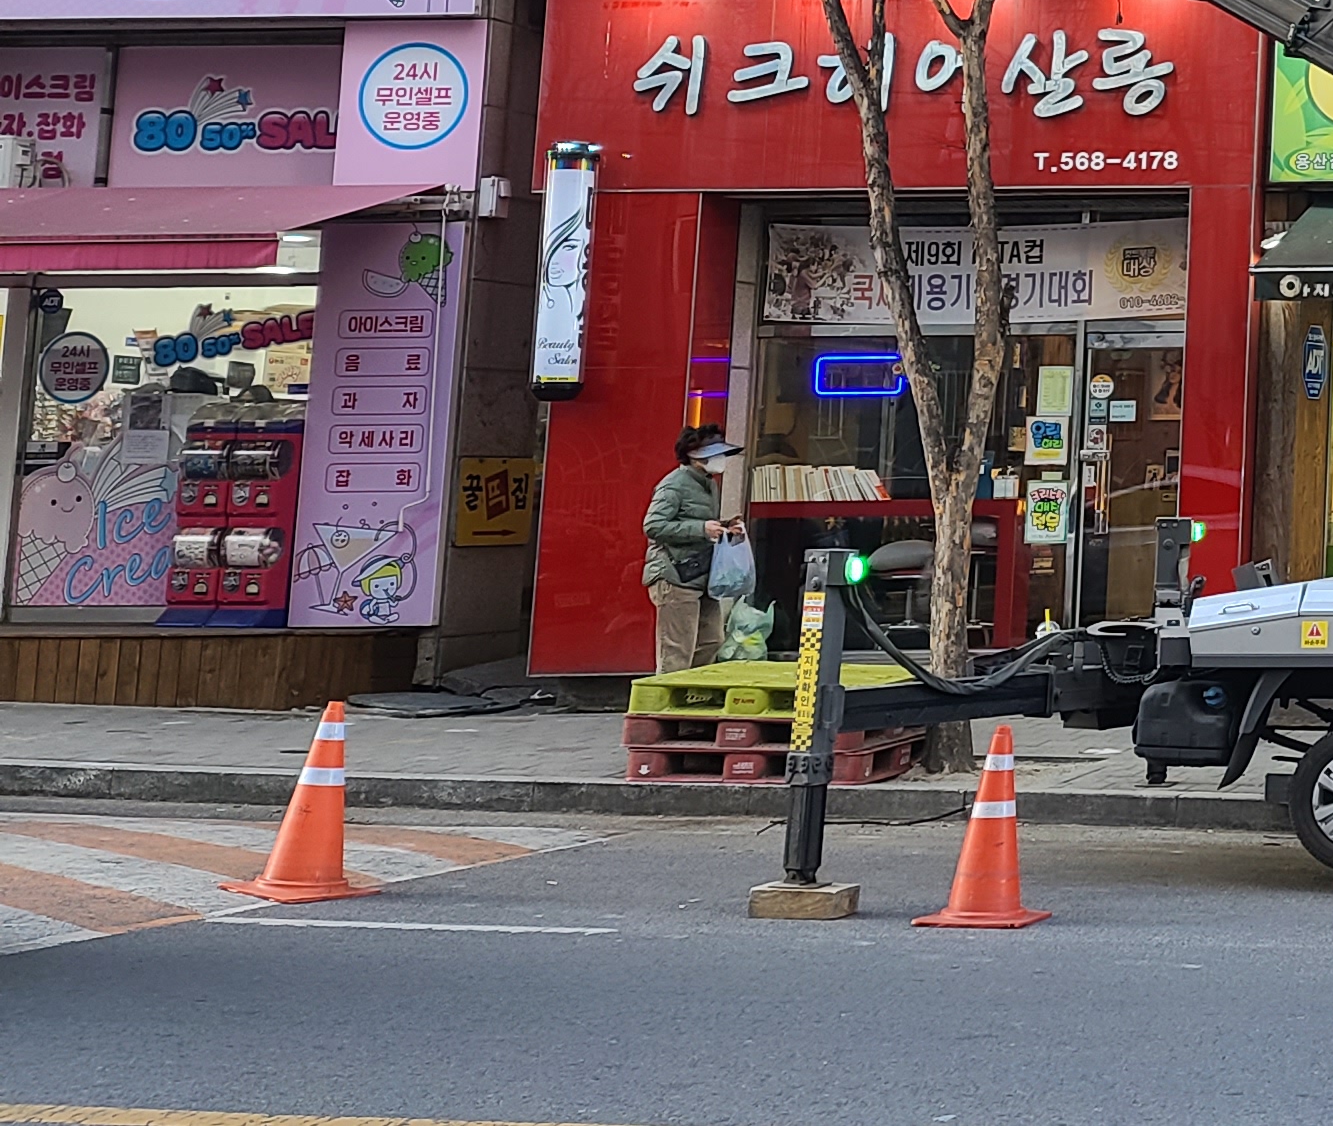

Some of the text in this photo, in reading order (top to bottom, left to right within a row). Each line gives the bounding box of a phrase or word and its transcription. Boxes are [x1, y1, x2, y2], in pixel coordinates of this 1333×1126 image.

[392, 62, 439, 82] 24시
[374, 86, 453, 108] 무인셀프
[133, 109, 197, 152] 80
[257, 109, 337, 151] SAL
[381, 111, 442, 132] 운영중
[1032, 150, 1180, 174] T.568-4178
[904, 240, 963, 267] 제9회
[347, 314, 425, 335] 아이스크림
[60, 345, 91, 359] 24시
[153, 332, 199, 368] 80
[49, 360, 100, 375] 무인셀프
[1305, 349, 1325, 375] ADT
[53, 376, 92, 392] 운영중
[95, 496, 172, 551] Ice
[64, 552, 173, 605] Crea
